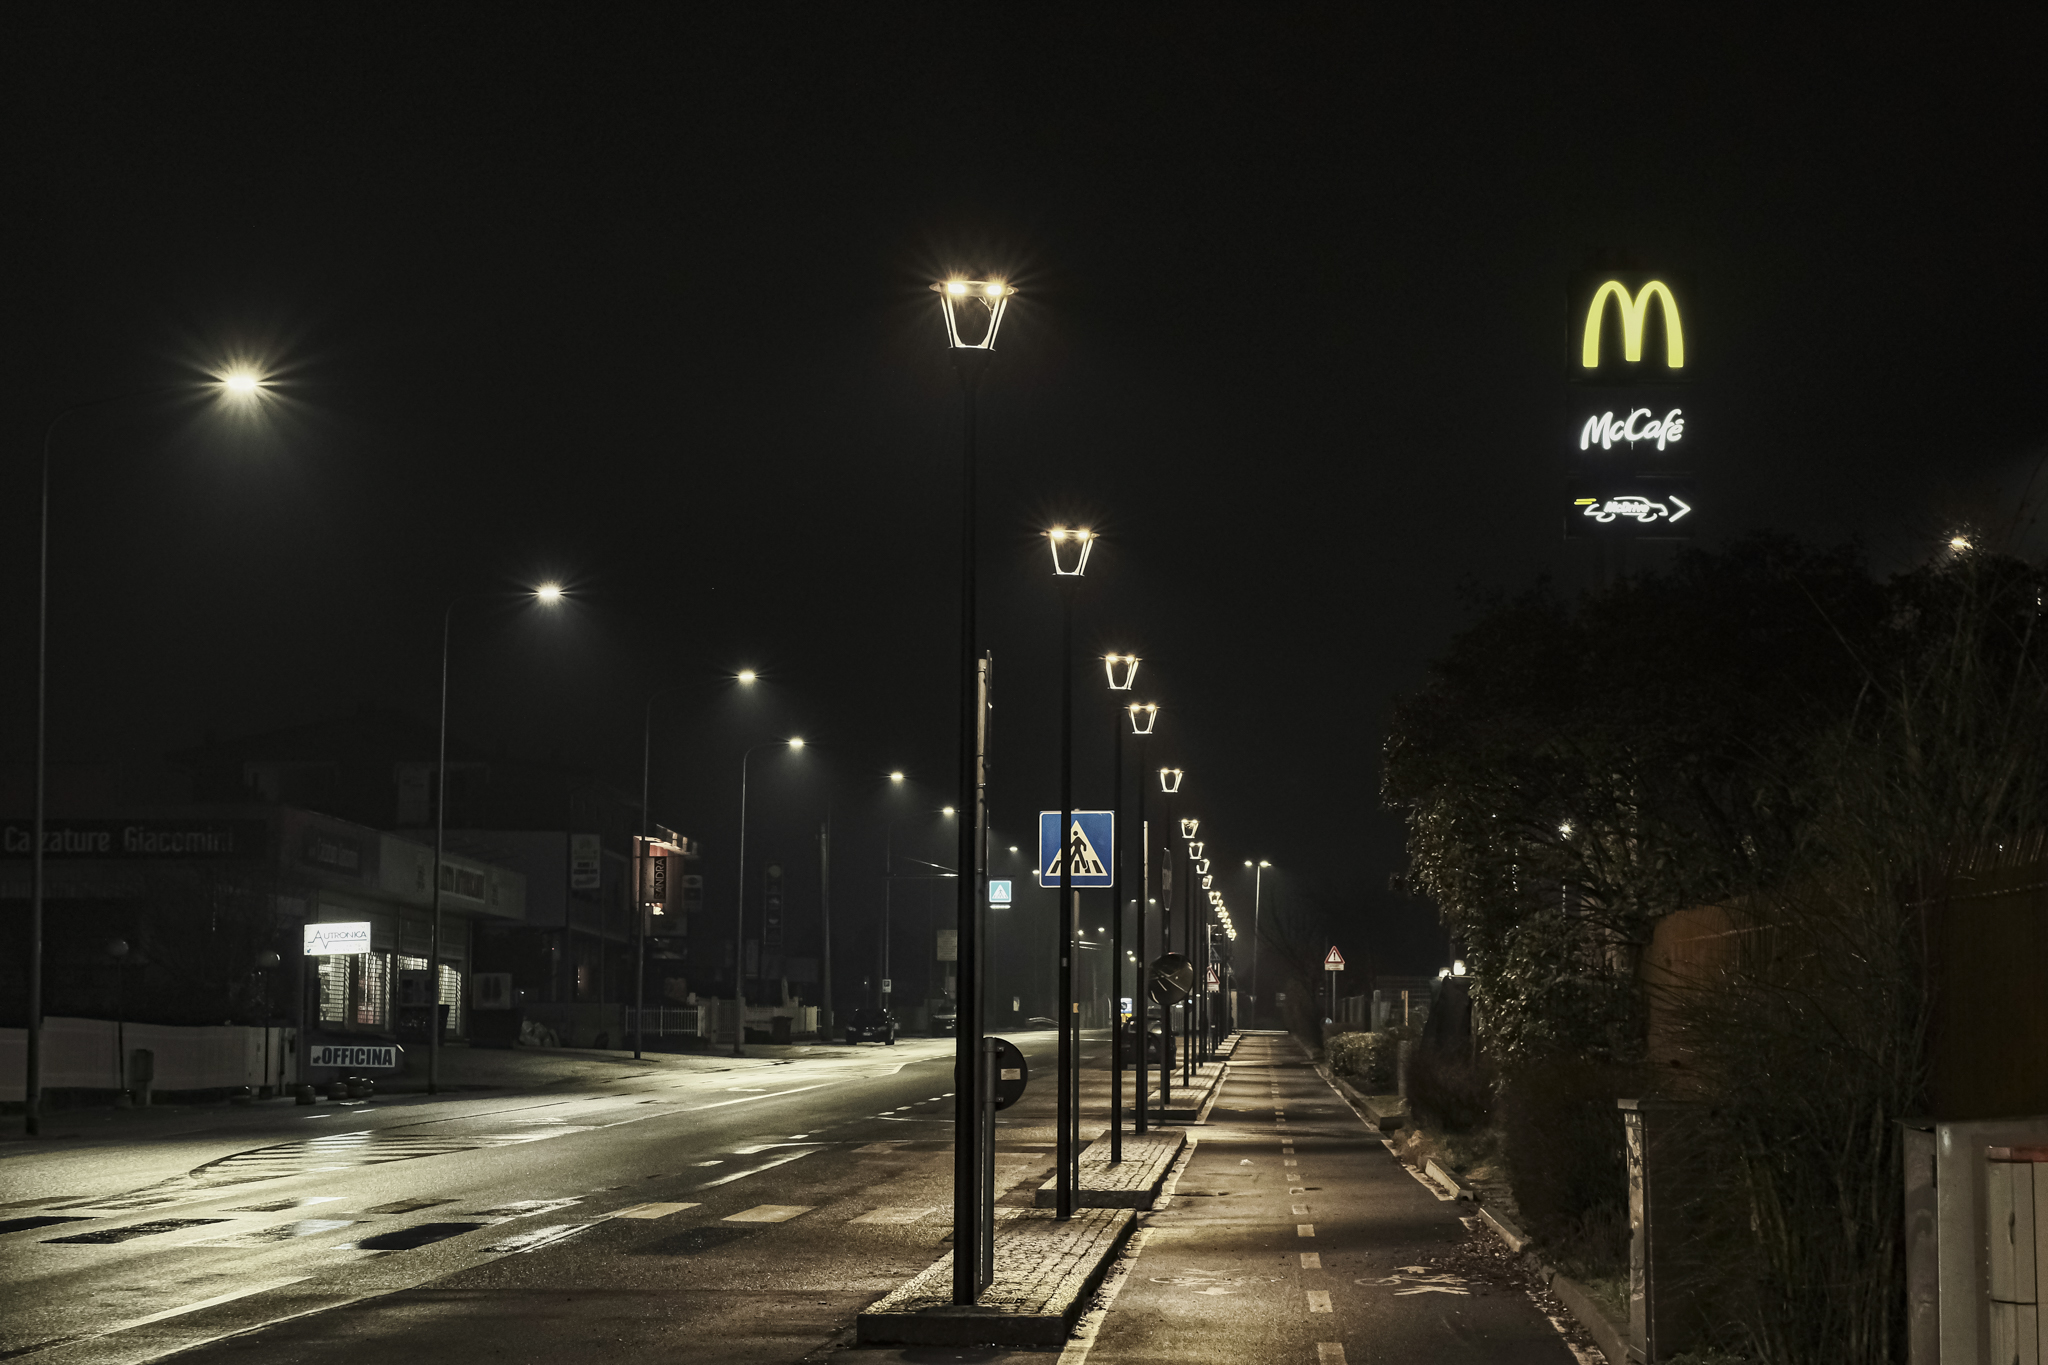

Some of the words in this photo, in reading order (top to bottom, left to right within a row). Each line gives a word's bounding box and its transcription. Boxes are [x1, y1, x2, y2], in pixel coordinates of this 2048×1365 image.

[1580, 408, 1685, 451] McCafé
[4, 826, 110, 852] Cazature
[654, 858, 665, 898] SANDRA
[322, 1047, 393, 1066] OFFICINA
